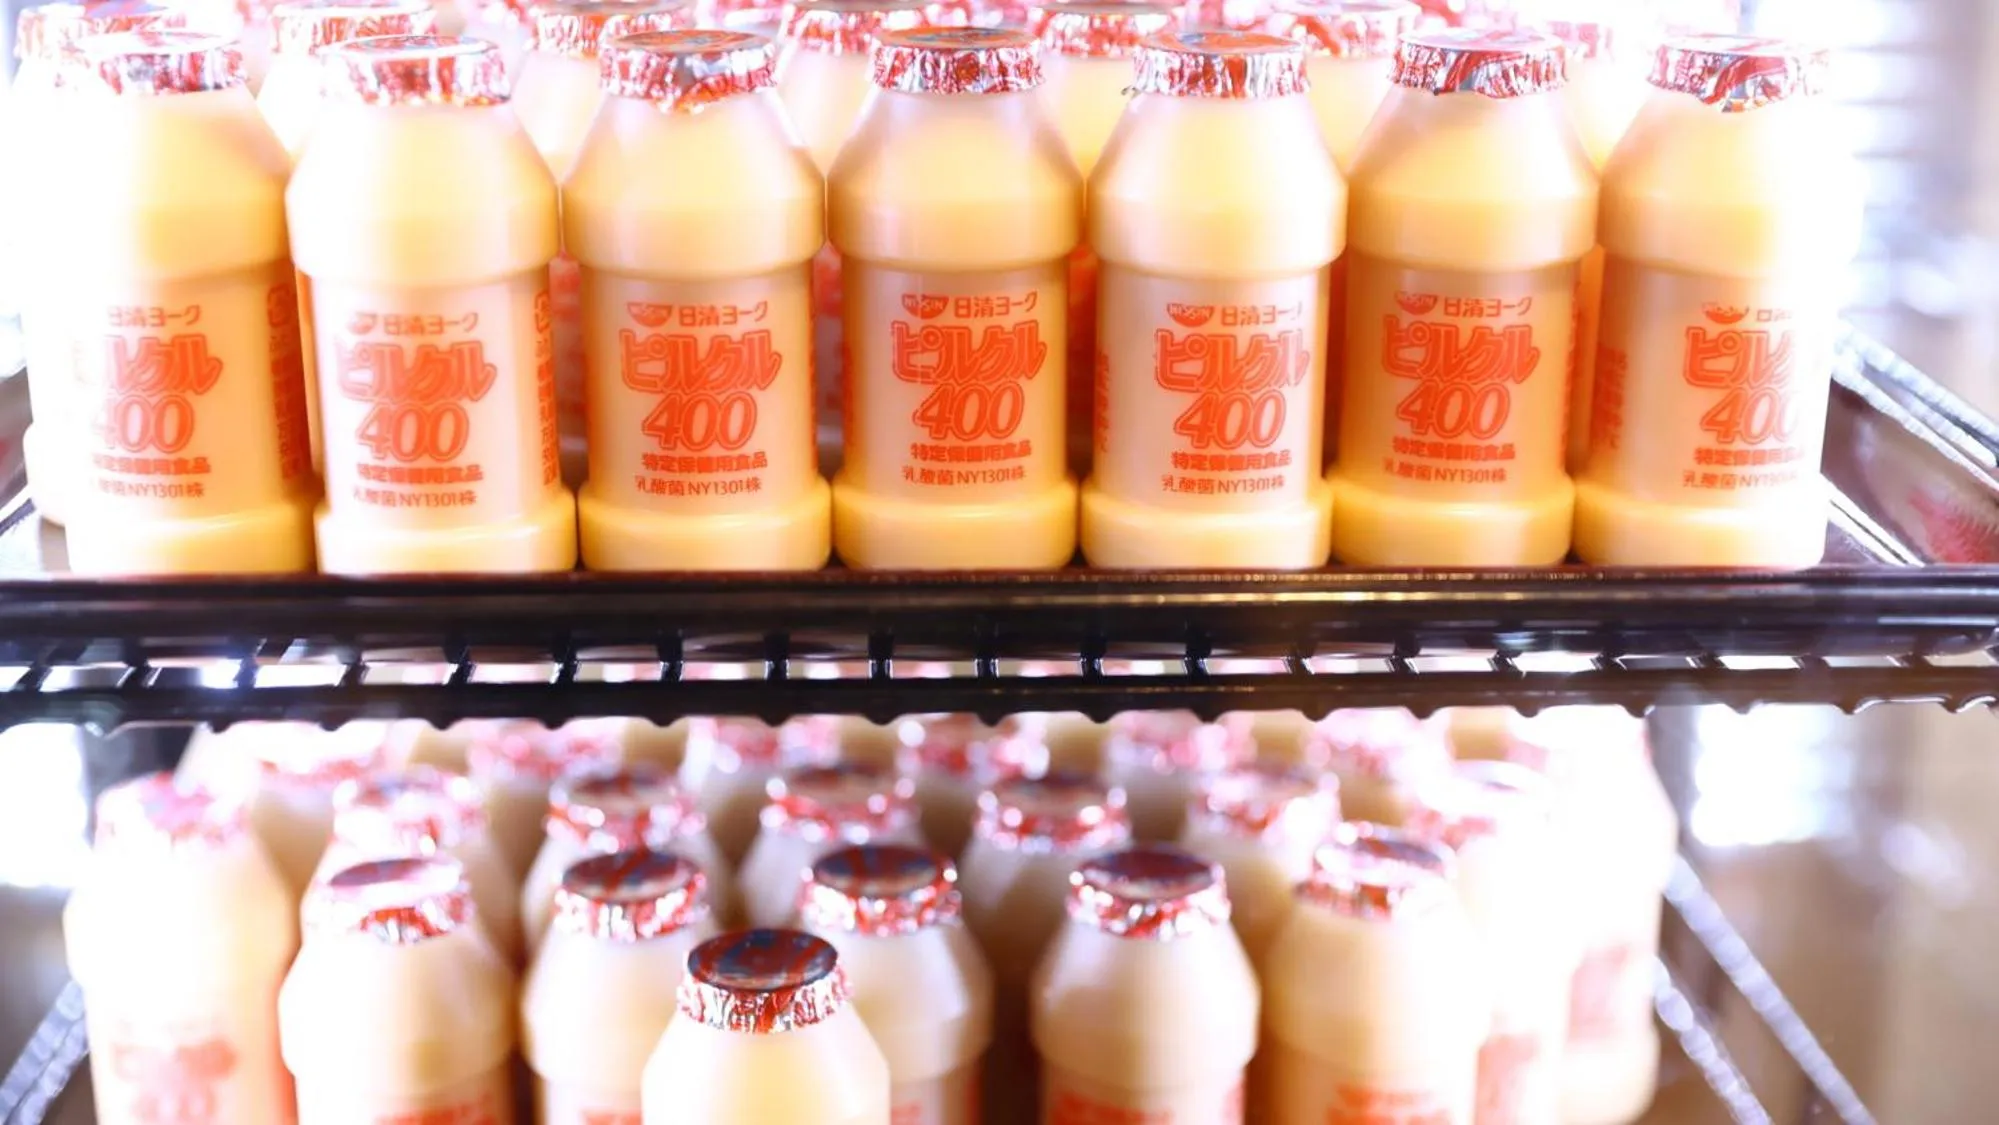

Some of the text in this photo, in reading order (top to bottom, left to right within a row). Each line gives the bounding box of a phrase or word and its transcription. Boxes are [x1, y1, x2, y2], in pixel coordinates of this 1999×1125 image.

[384, 312, 479, 335] 日清ヨーク
[678, 300, 768, 327] 日清ヨーク
[954, 291, 1038, 318] 日清ヨーク
[1443, 297, 1532, 318] 日清ヨーク
[334, 337, 498, 404] ピルクル
[619, 328, 782, 394] ピルクル
[891, 319, 1047, 385] ピルクル
[1155, 328, 1310, 393] ピルクル
[1381, 314, 1541, 384] ピルクル
[356, 401, 470, 462] 400
[642, 391, 757, 451] 400
[912, 380, 1025, 441] 400
[1174, 389, 1286, 450] 400
[1396, 379, 1510, 439] 400
